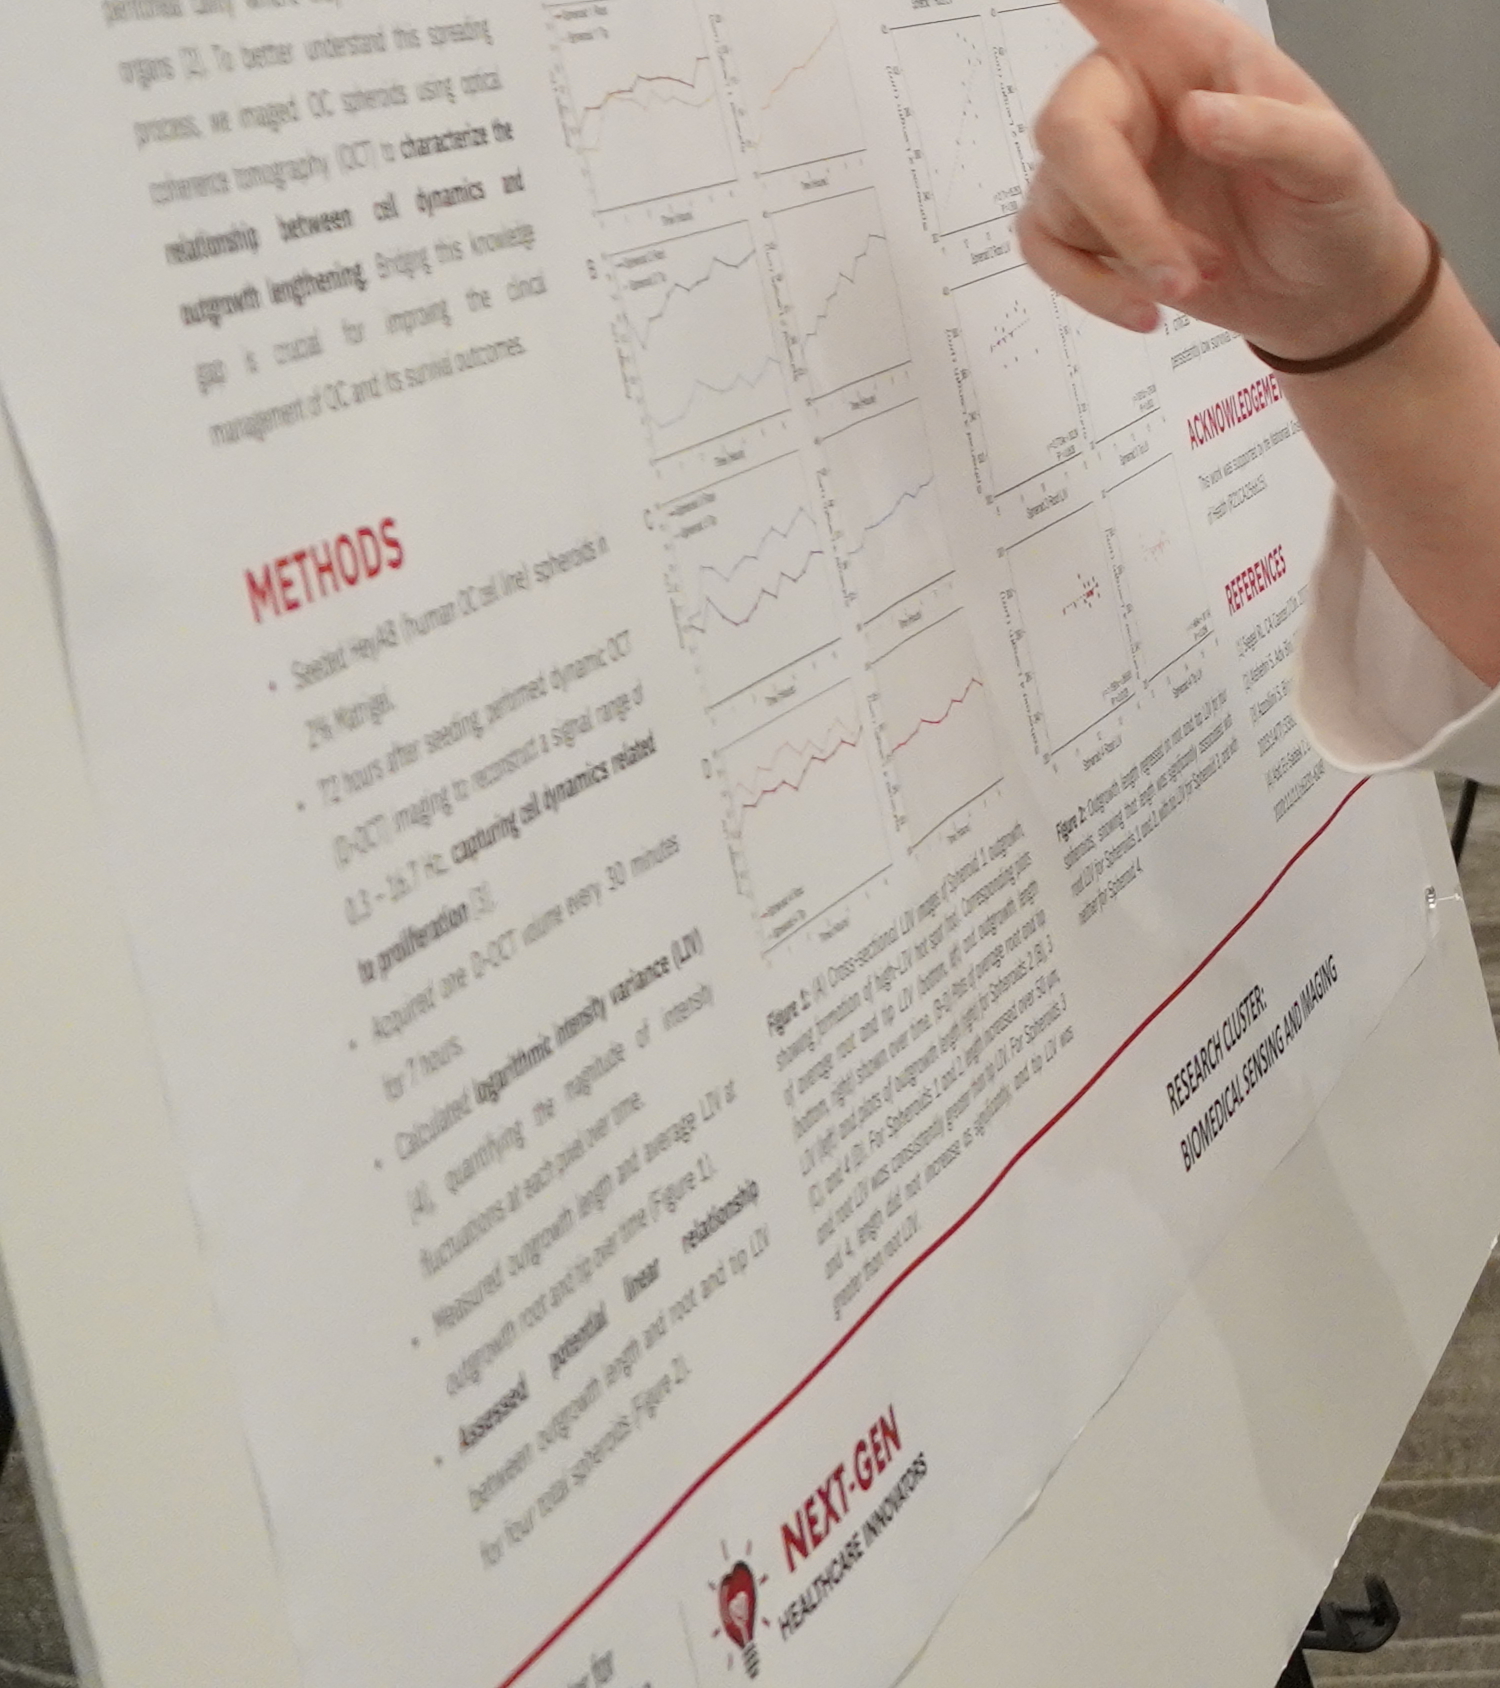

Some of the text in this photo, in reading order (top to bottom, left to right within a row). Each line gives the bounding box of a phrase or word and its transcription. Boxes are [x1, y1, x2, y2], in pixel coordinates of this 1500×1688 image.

[244, 516, 404, 624] METHODS
[1225, 544, 1287, 615] REFERENCES
[1167, 984, 1267, 1115] RESEARCH CLUSTER:
[1180, 954, 1338, 1172] BIOMEDICAL SENSING AND IMAGING
[780, 1403, 902, 1573] NEXT-GEN
